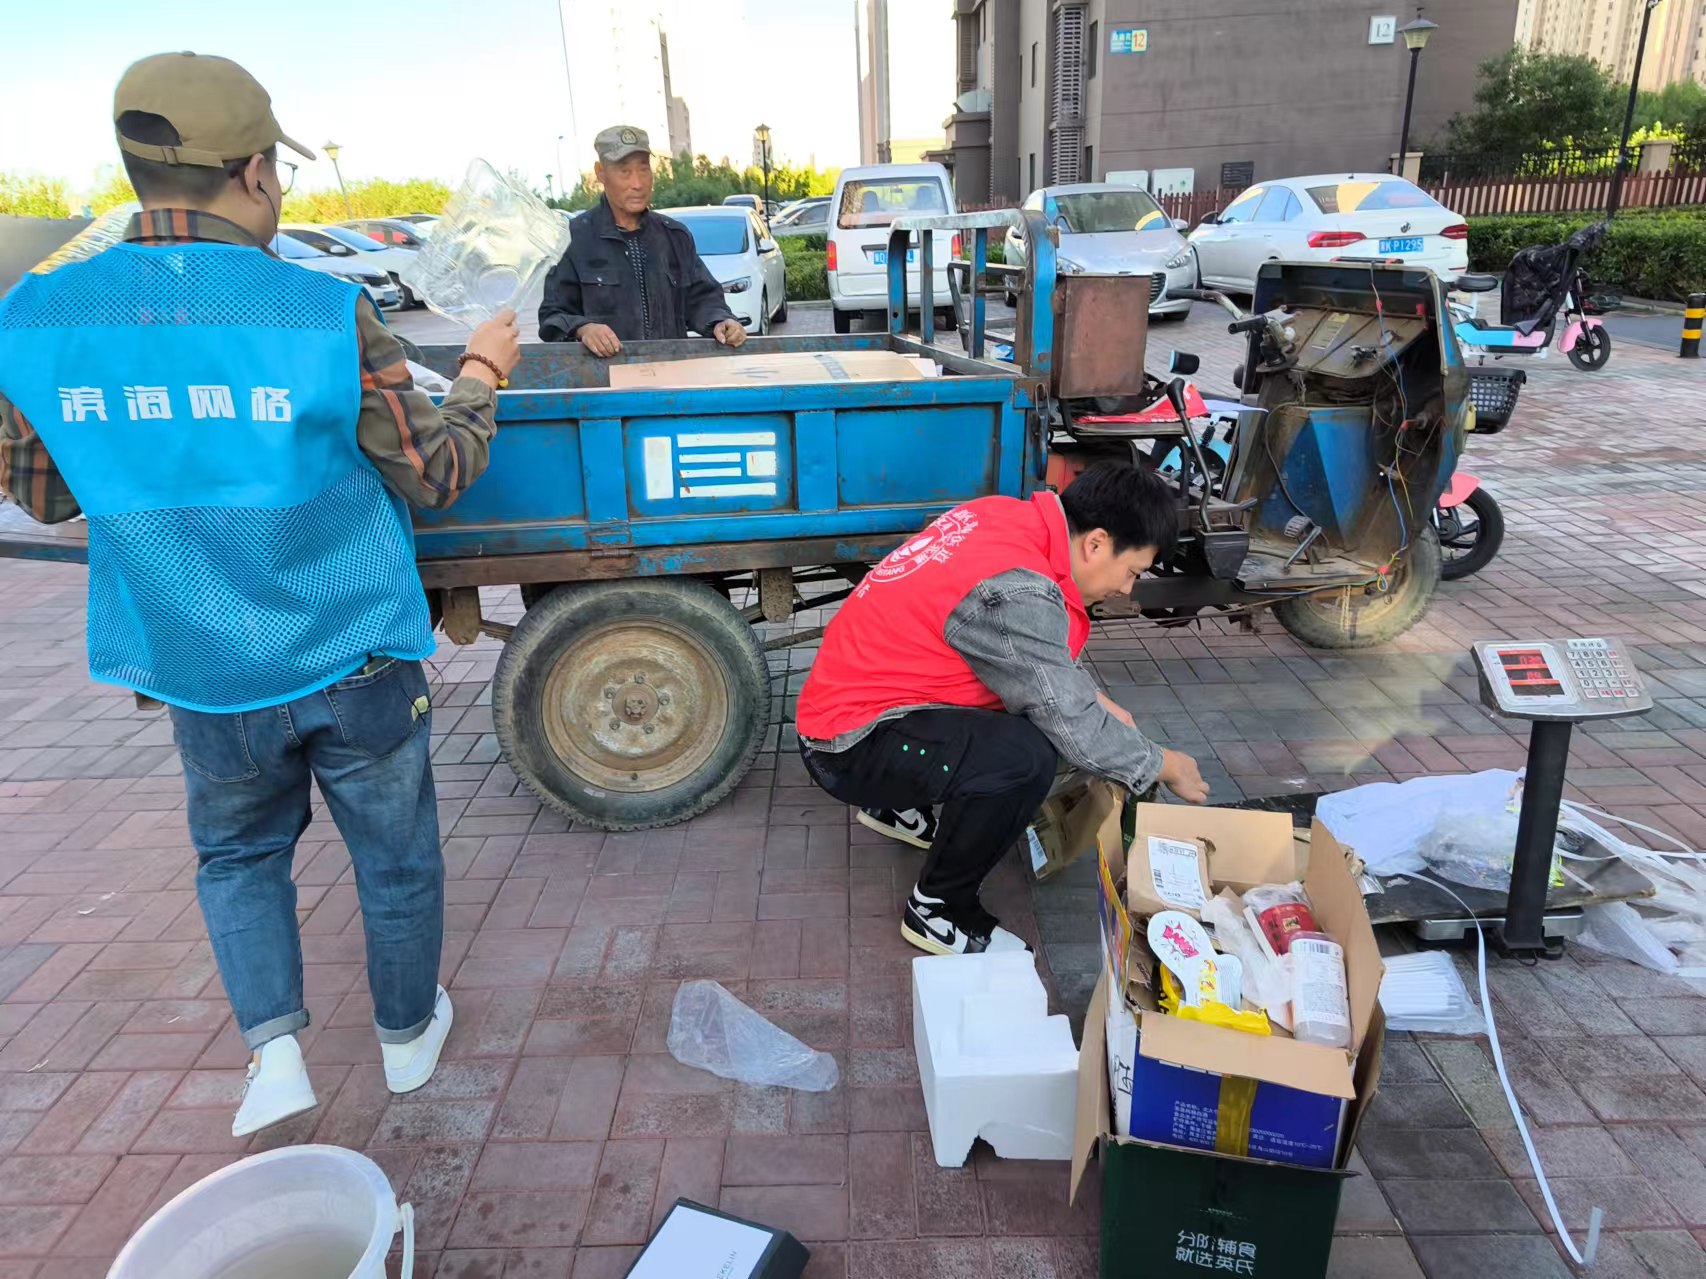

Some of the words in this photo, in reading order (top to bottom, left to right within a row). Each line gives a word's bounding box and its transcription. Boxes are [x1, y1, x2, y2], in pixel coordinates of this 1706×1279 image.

[1133, 32, 1145, 49] 12
[1376, 22, 1391, 38] 12
[58, 385, 292, 422] 滨海网格
[1175, 1246, 1255, 1276] 就选英氏
